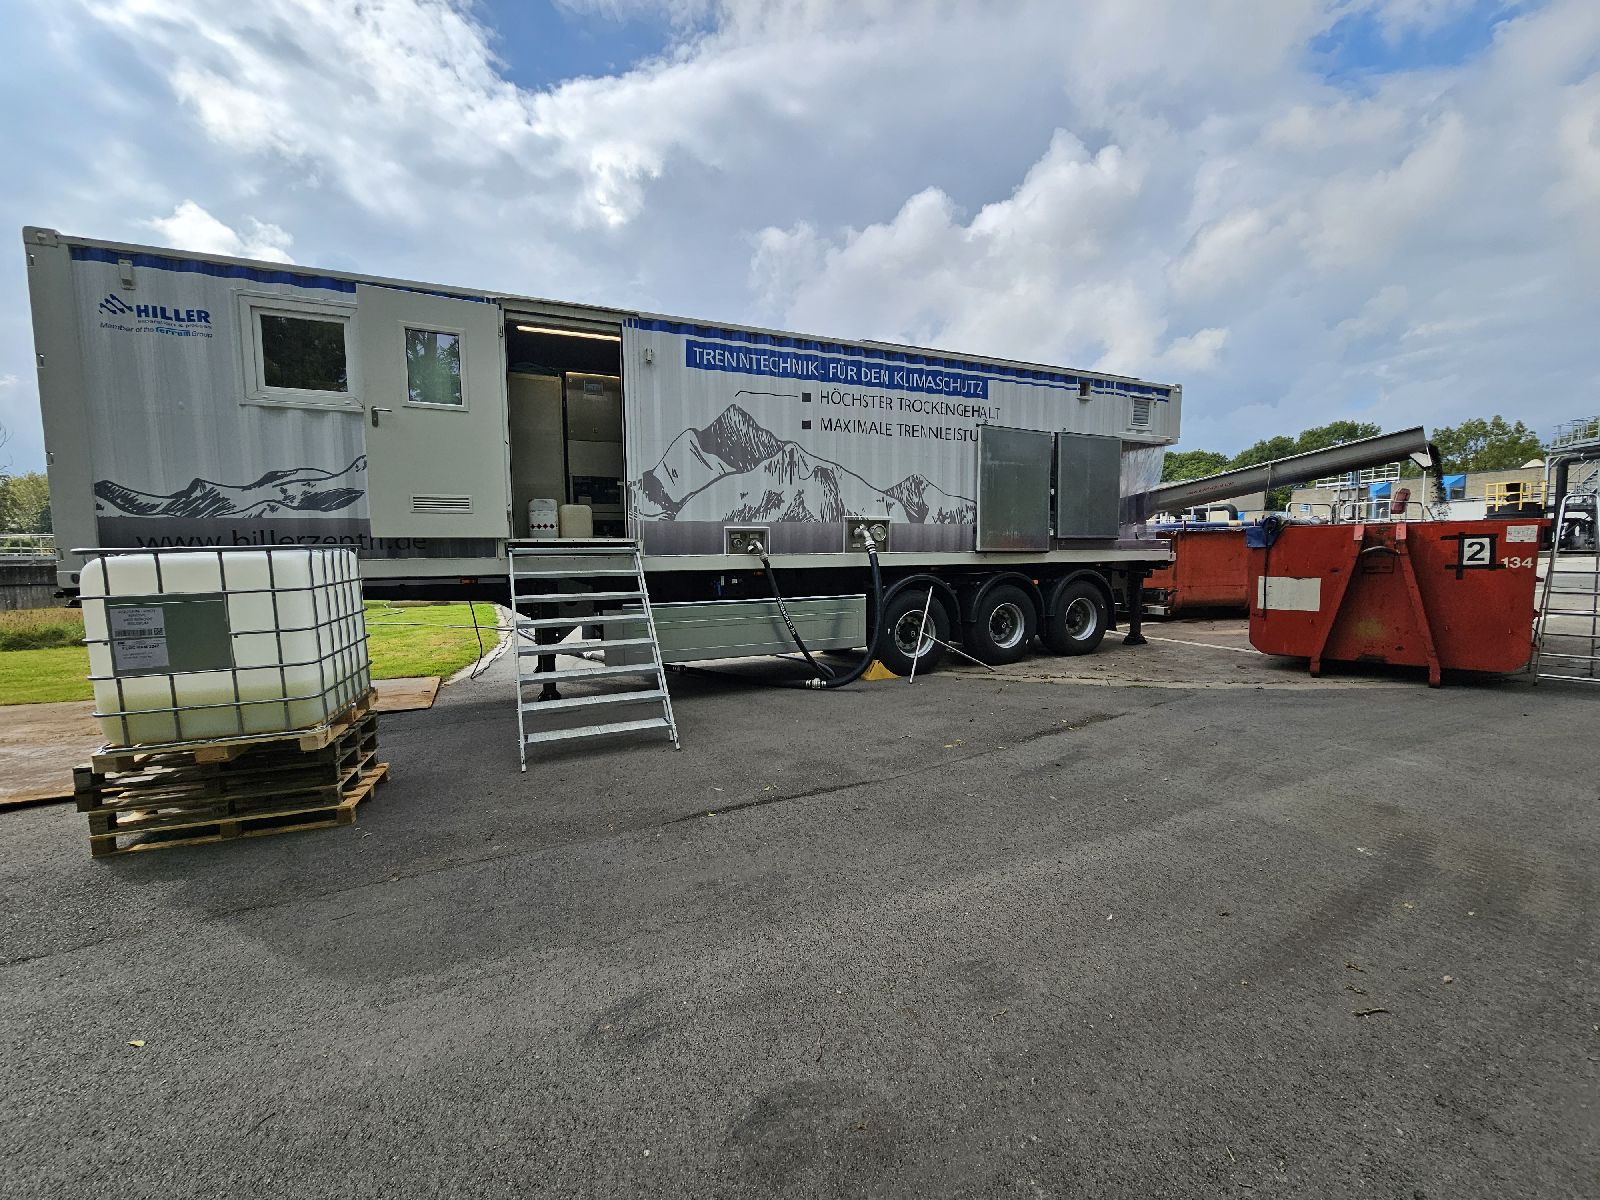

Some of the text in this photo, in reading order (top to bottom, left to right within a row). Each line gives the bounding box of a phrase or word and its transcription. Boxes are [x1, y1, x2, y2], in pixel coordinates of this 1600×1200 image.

[136, 304, 211, 323] HILLER
[100, 321, 134, 333] Member
[191, 330, 213, 339] Group
[829, 362, 857, 381] FÜR
[861, 368, 889, 385] DEN
[894, 371, 983, 395] KLIMASCHUTZ
[820, 388, 1001, 420] HÖCHSTER TROCKENGEHALT
[820, 418, 978, 442] MAXIMALE TRENNLEISTU
[1466, 541, 1486, 562] 2
[1501, 556, 1534, 568] 134
